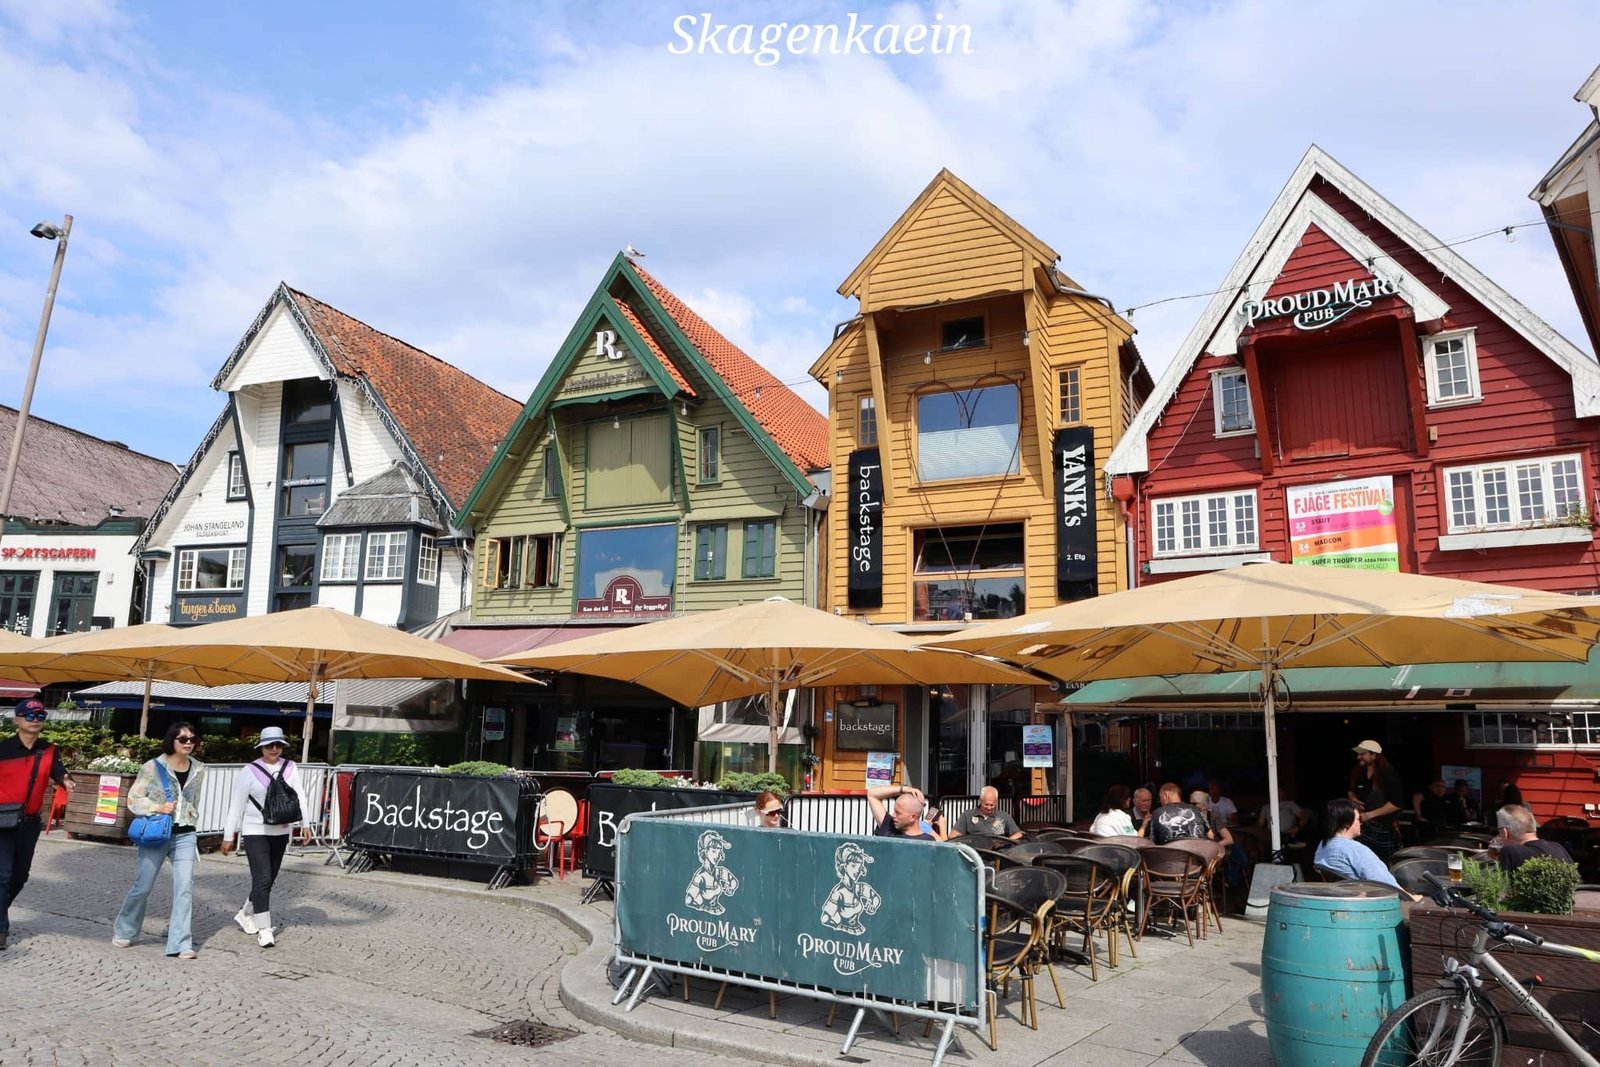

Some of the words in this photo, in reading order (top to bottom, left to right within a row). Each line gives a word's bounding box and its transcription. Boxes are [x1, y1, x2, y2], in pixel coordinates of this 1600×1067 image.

[1239, 289, 1331, 328] PROUD
[1333, 276, 1402, 305] MARY
[1304, 307, 1335, 323] PUB
[595, 329, 623, 360] R
[1294, 492, 1331, 514] FJÅGE
[183, 523, 203, 532] JOHAN
[204, 520, 245, 531] STANGELAND
[853, 465, 880, 572] backstage
[1311, 518, 1331, 526] STAUT
[1314, 537, 1342, 546] MADCON
[1, 547, 96, 558] SPORTSCAFEEN
[1074, 553, 1086, 562] Etg
[1311, 557, 1332, 566] SUPER
[1333, 557, 1363, 565] TROUPER
[615, 588, 631, 605] R
[178, 598, 208, 621] burger
[208, 603, 215, 614] &
[212, 597, 237, 614] beers
[840, 718, 891, 735] backstage
[363, 784, 504, 849] Backstage
[666, 912, 718, 937] PROUD
[718, 920, 757, 943] MARY
[701, 936, 718, 948] PUB
[797, 933, 856, 959] PROUD
[855, 941, 904, 965] MARY
[838, 958, 856, 971] PUB
